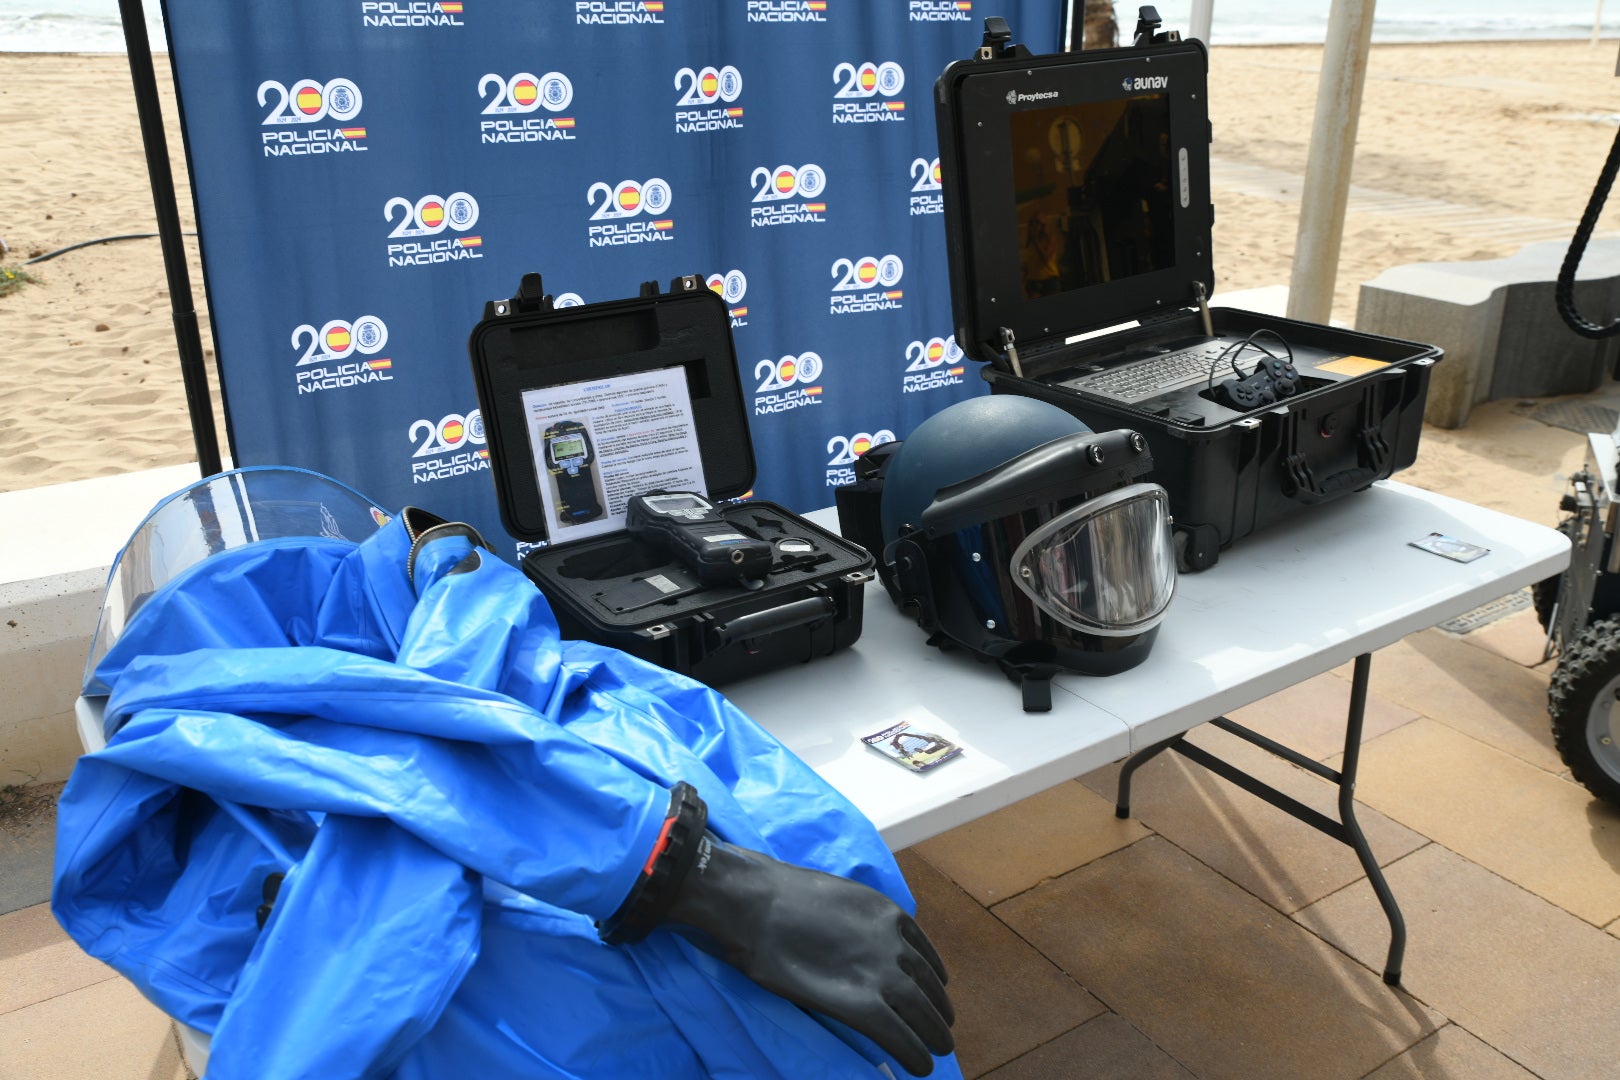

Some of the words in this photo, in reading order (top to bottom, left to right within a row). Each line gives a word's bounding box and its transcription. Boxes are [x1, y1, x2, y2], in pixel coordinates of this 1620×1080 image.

[362, 2, 444, 13] POLICIA
[576, 2, 648, 12] POLICIA
[748, 1, 812, 11] POLICIA
[910, 1, 960, 10] POLICIA
[363, 15, 464, 26] NACIONAL
[577, 14, 664, 24] NACIONAL
[748, 12, 826, 21] NACIONAL
[910, 12, 971, 21] NACIONAL
[674, 65, 742, 106] 200
[833, 61, 905, 98] 200
[1134, 76, 1168, 90] aunav
[478, 72, 573, 114] 200
[1018, 91, 1059, 102] Proytecsa
[257, 78, 362, 125] 200
[833, 102, 890, 113] POLICIA
[676, 109, 730, 122] POLICIA
[833, 112, 904, 123] NACIONAL
[481, 119, 558, 131] POLICIA
[676, 119, 743, 133] NACIONAL
[262, 129, 346, 144] POLICIA
[482, 130, 576, 143] NACIONAL
[264, 140, 368, 156] NACIONAL
[751, 164, 826, 202] 200
[587, 178, 672, 220] 200
[910, 195, 943, 206] POLI
[384, 192, 479, 238] 200
[751, 204, 810, 217] POLICIA
[751, 213, 826, 227] NACIONAL
[589, 222, 657, 236] POLICIA
[590, 231, 673, 247] NACIONAL
[388, 238, 464, 255] POLICIA
[389, 249, 483, 267] NACIONAL
[831, 254, 903, 291] 200
[831, 292, 890, 305] POLICIA
[831, 301, 902, 314] NACIONAL
[291, 315, 388, 367] 200
[296, 362, 373, 383] POLICIA
[755, 351, 823, 393] 200
[904, 370, 953, 384] POLICIA
[298, 371, 393, 394] NACIONAL
[903, 376, 963, 393] NACIONAL
[755, 389, 809, 406] POLICIA
[755, 396, 822, 415] NACIONAL
[412, 451, 483, 473] POLICIA
[414, 460, 491, 483] NACIONA
